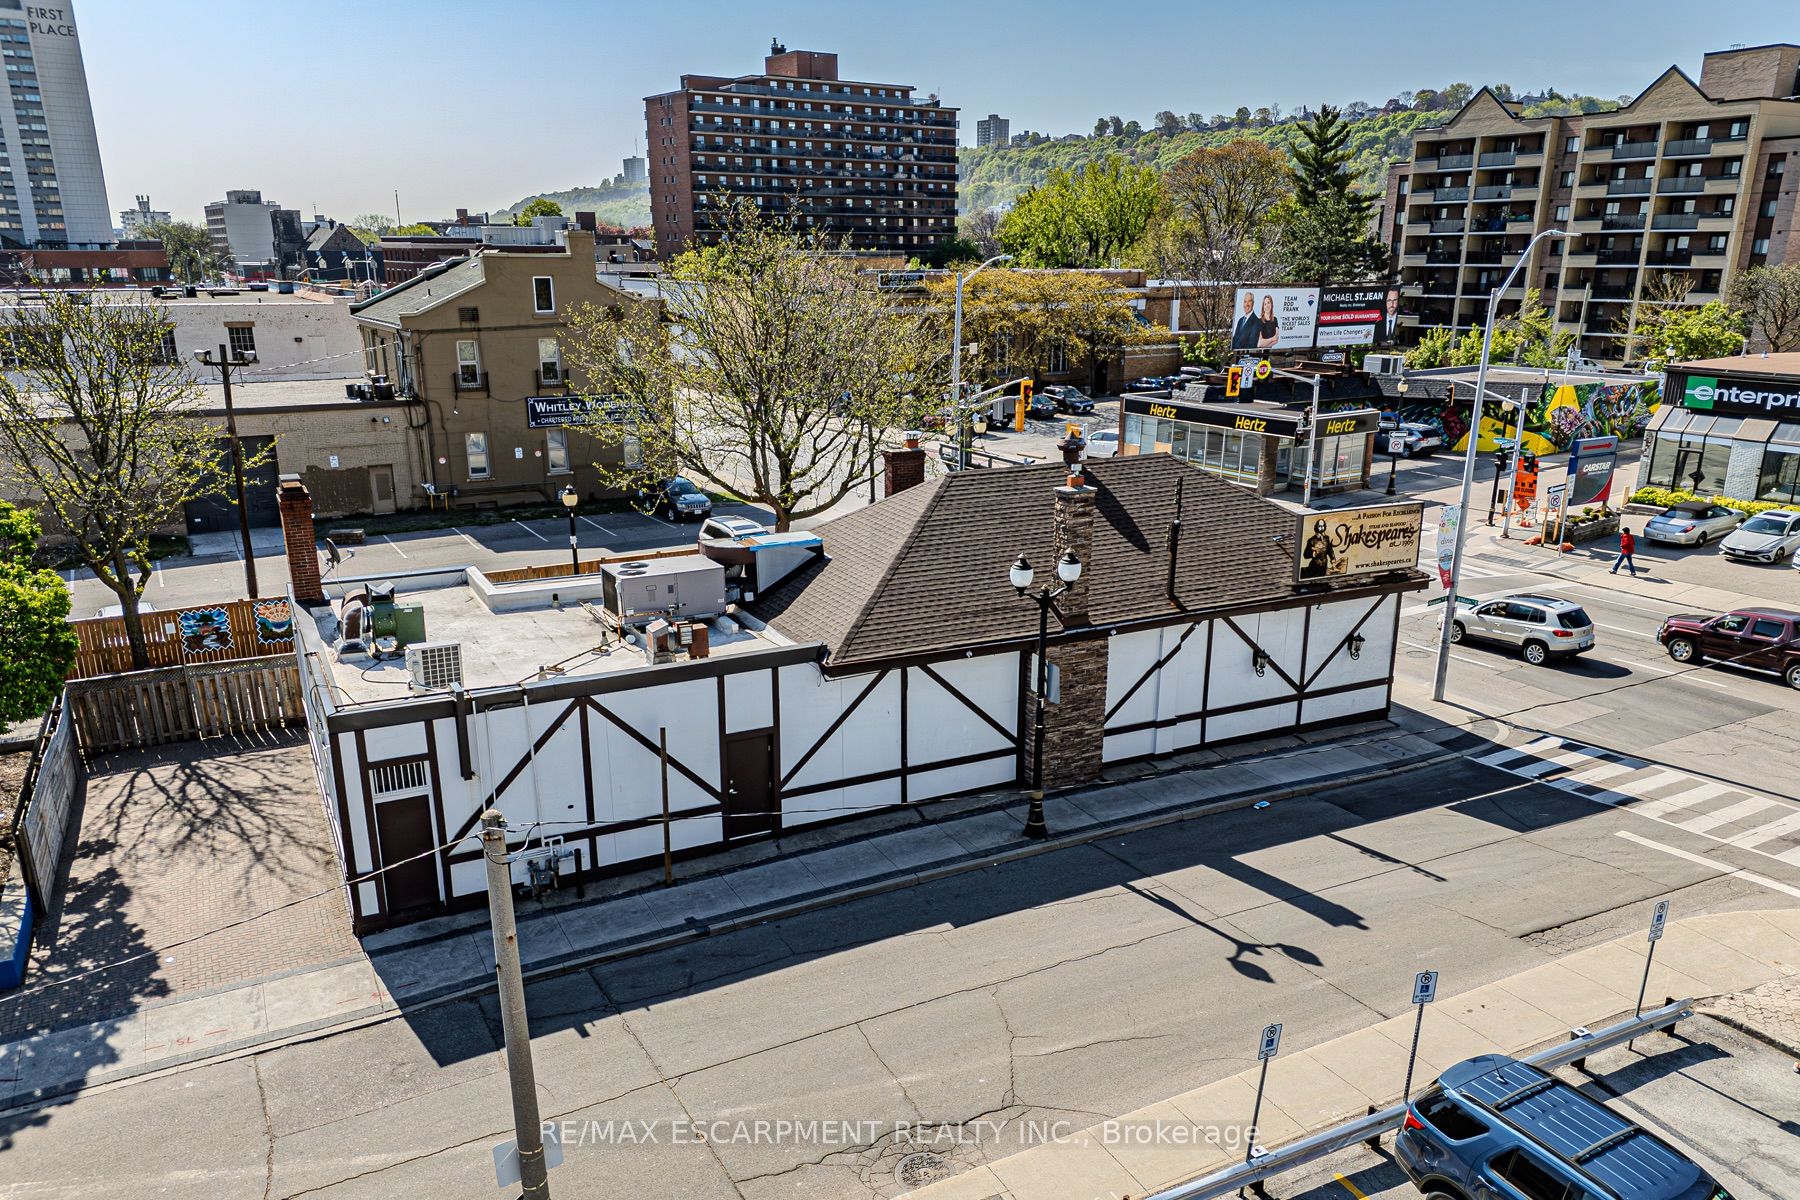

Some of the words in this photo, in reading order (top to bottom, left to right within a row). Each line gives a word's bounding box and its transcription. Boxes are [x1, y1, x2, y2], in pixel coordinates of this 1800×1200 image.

[27, 7, 63, 20] FIRST
[29, 22, 75, 37] PLACE
[1323, 293, 1353, 302] MICHAEL
[535, 401, 581, 413] WHITLEY
[1149, 403, 1177, 419] Hertz
[1235, 416, 1267, 432] Hertz
[1326, 419, 1357, 434] Hertz
[1583, 462, 1611, 472] CARSTAR
[1331, 522, 1419, 554] Shakespeare's
[1355, 557, 1412, 569] www.shakespeares.ca
